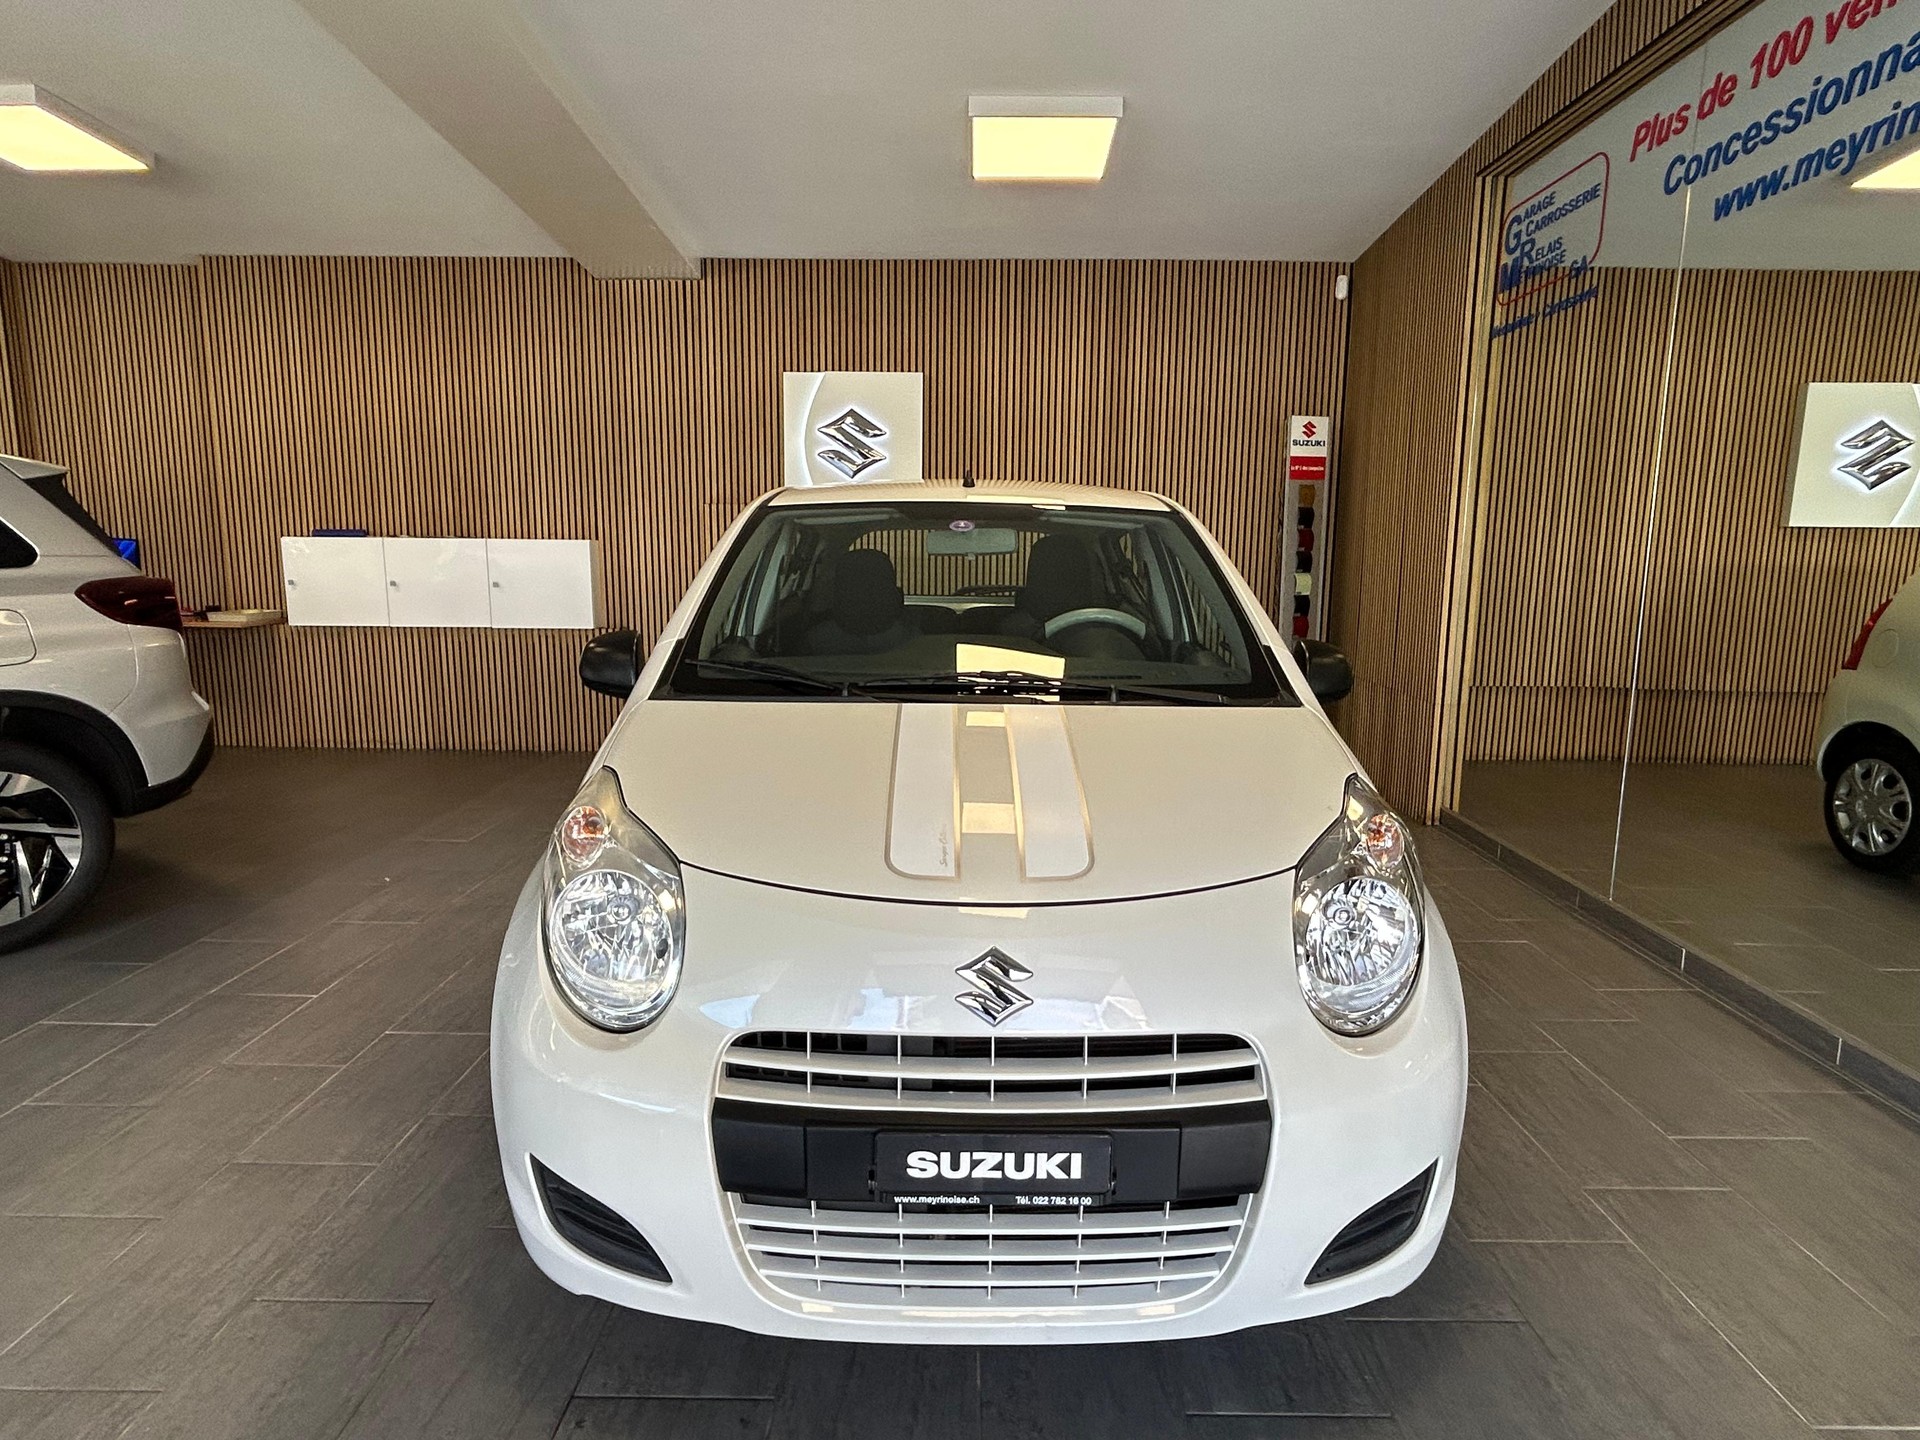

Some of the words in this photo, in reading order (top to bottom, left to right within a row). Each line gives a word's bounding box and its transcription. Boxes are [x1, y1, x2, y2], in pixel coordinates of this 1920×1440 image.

[1629, 103, 1692, 162] Plus
[1696, 71, 1738, 121] de
[1750, 15, 1815, 90] 100
[1663, 30, 1920, 196] Concessionna
[1713, 100, 1920, 222] www.meyrin
[1525, 182, 1602, 237] CARROSSERIE
[1292, 438, 1326, 447] SUZUKI
[905, 1150, 1083, 1180] SUZUKI
[893, 1195, 981, 1205] www.meyrinoise.ch
[1015, 1195, 1031, 1205] Tél.
[1032, 1196, 1049, 1205] 022
[1080, 1197, 1093, 1206] 00
